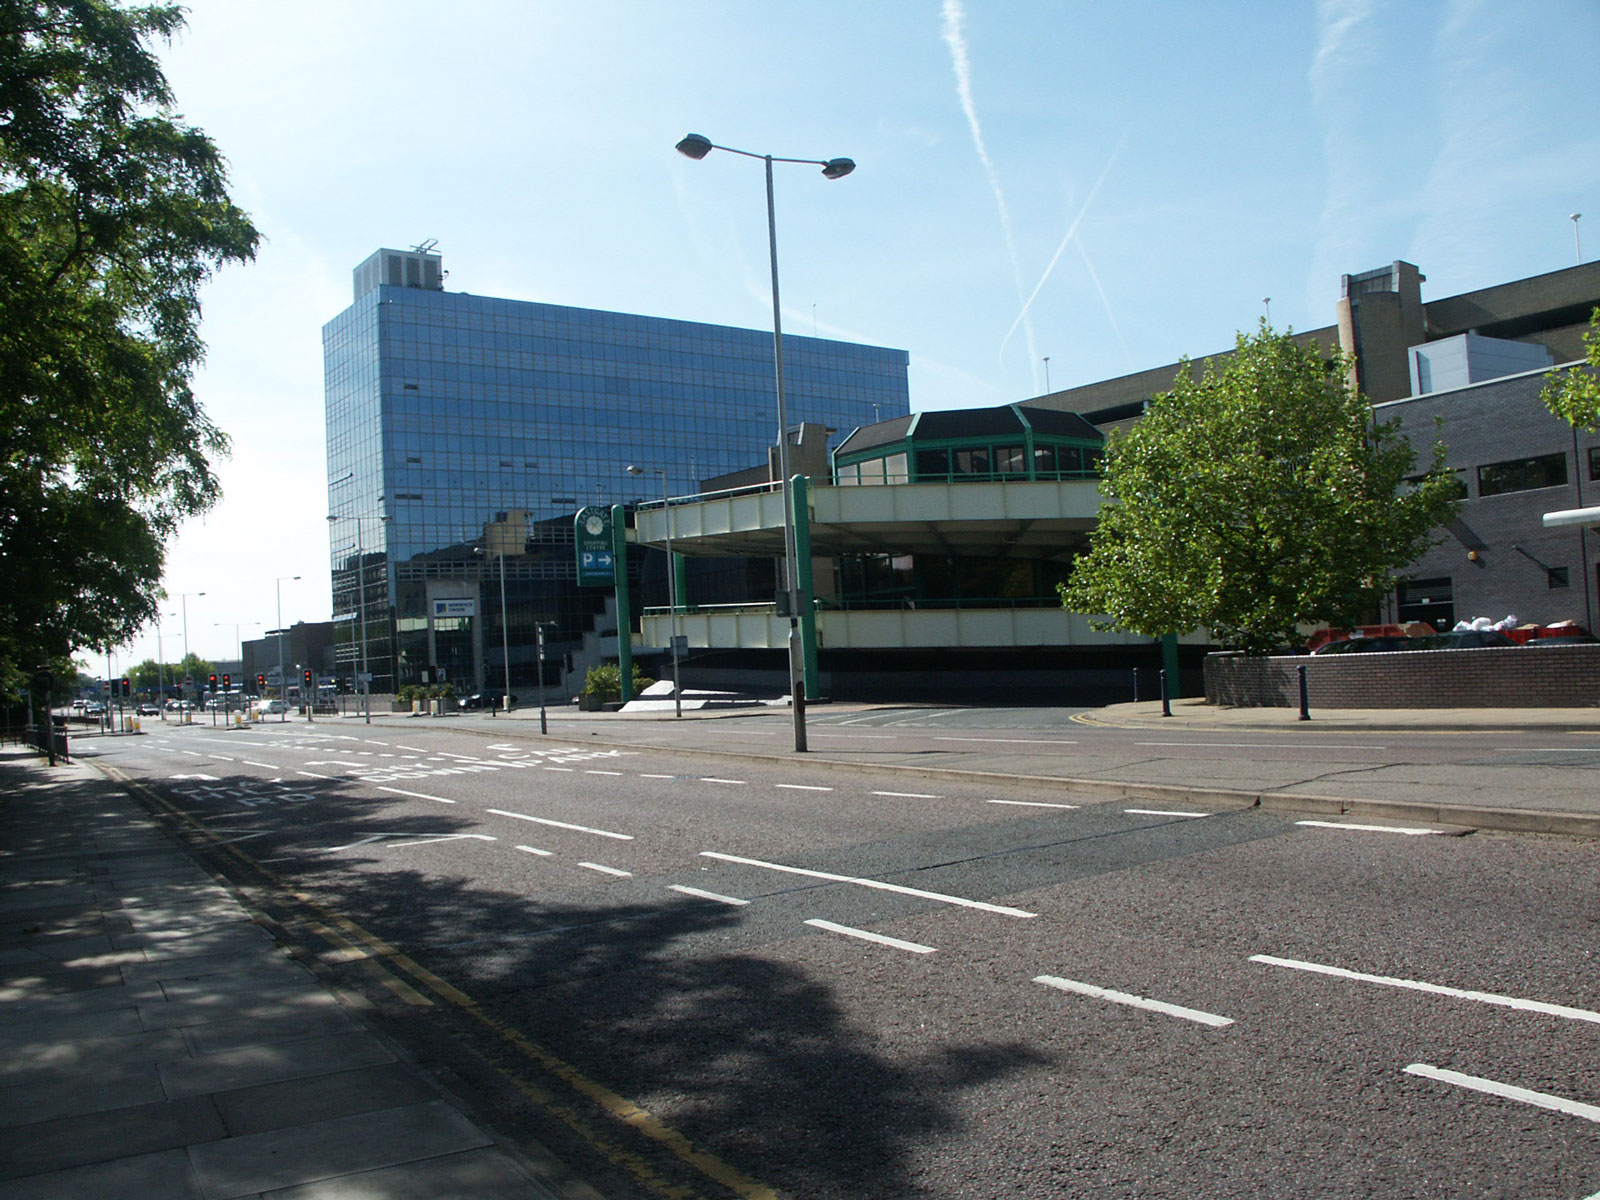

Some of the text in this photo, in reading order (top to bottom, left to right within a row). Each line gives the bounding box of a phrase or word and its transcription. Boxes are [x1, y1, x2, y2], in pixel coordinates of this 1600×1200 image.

[583, 553, 593, 567] P
[190, 785, 317, 801] HILL
[236, 793, 316, 807] RD
